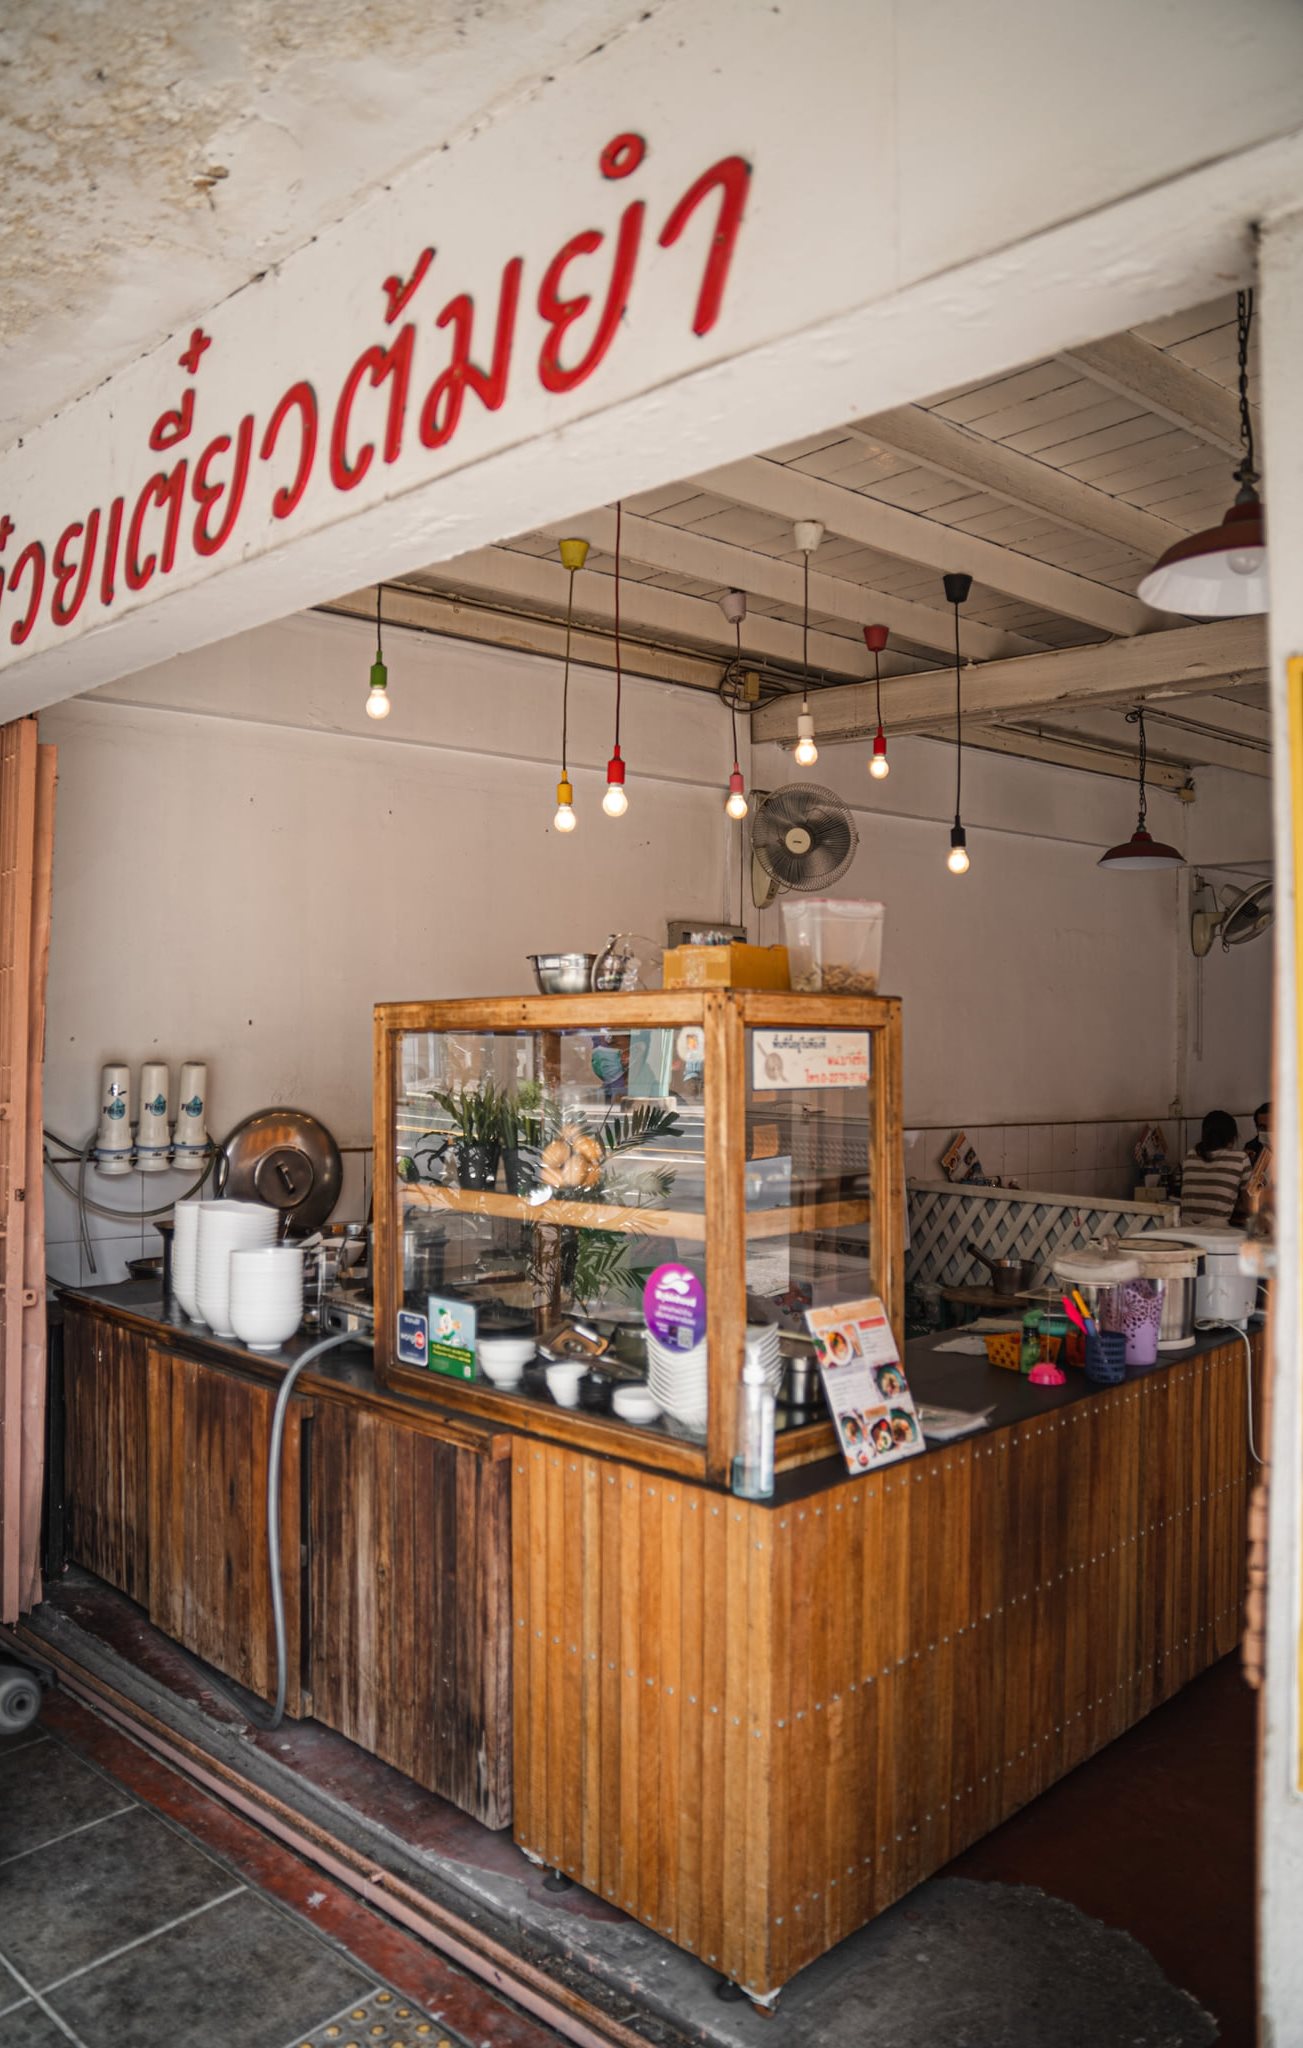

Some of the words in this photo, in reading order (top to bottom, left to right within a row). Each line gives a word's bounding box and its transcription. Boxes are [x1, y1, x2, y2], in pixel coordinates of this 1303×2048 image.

[0, 132, 751, 646] ๋วยเตี๋ยวต้มยำ
